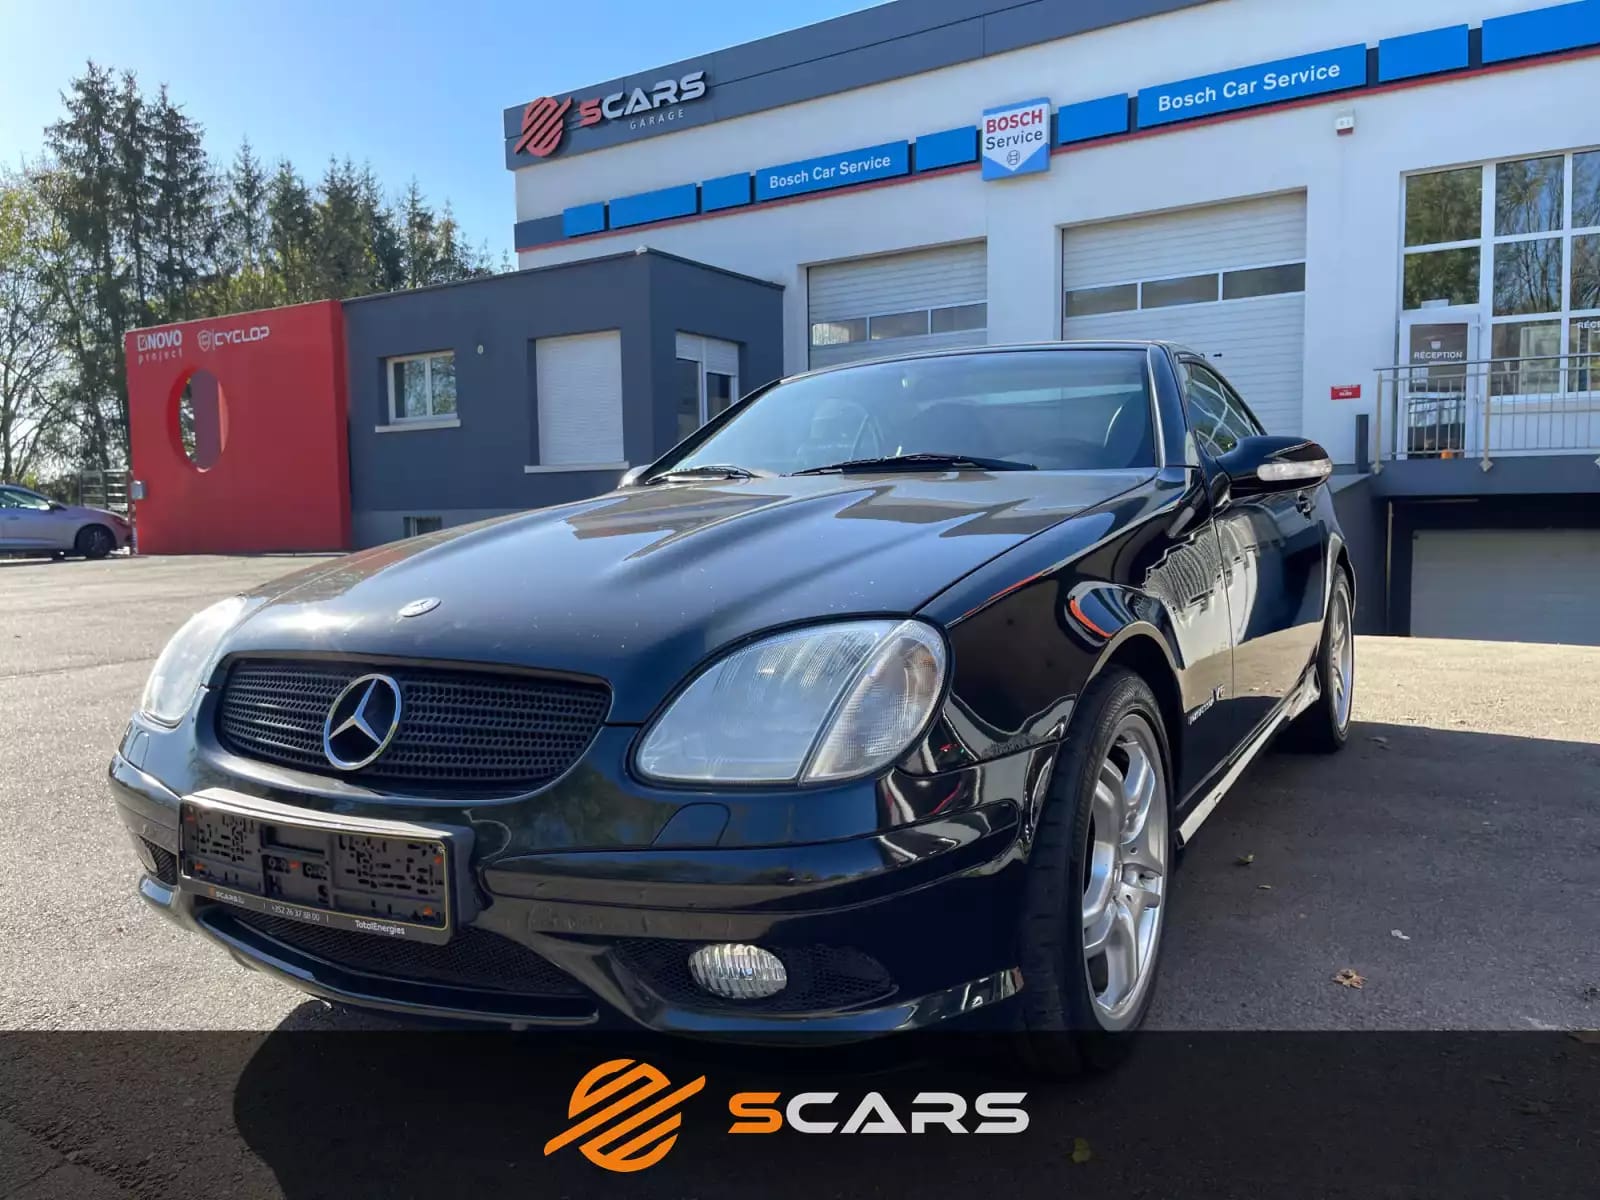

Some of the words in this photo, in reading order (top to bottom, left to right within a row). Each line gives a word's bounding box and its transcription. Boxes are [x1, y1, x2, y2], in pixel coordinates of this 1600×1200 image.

[578, 70, 706, 128] SCARS
[1158, 88, 1216, 112] Bosch
[1223, 81, 1257, 97] Car
[1263, 63, 1341, 91] Service
[630, 108, 684, 130] GARAGE
[986, 108, 1043, 134] BOSCH
[985, 129, 1043, 151] Service
[769, 168, 809, 189] Bosch
[812, 163, 835, 180] Car
[839, 154, 891, 175] Service
[355, 919, 405, 935] TotalEnergies
